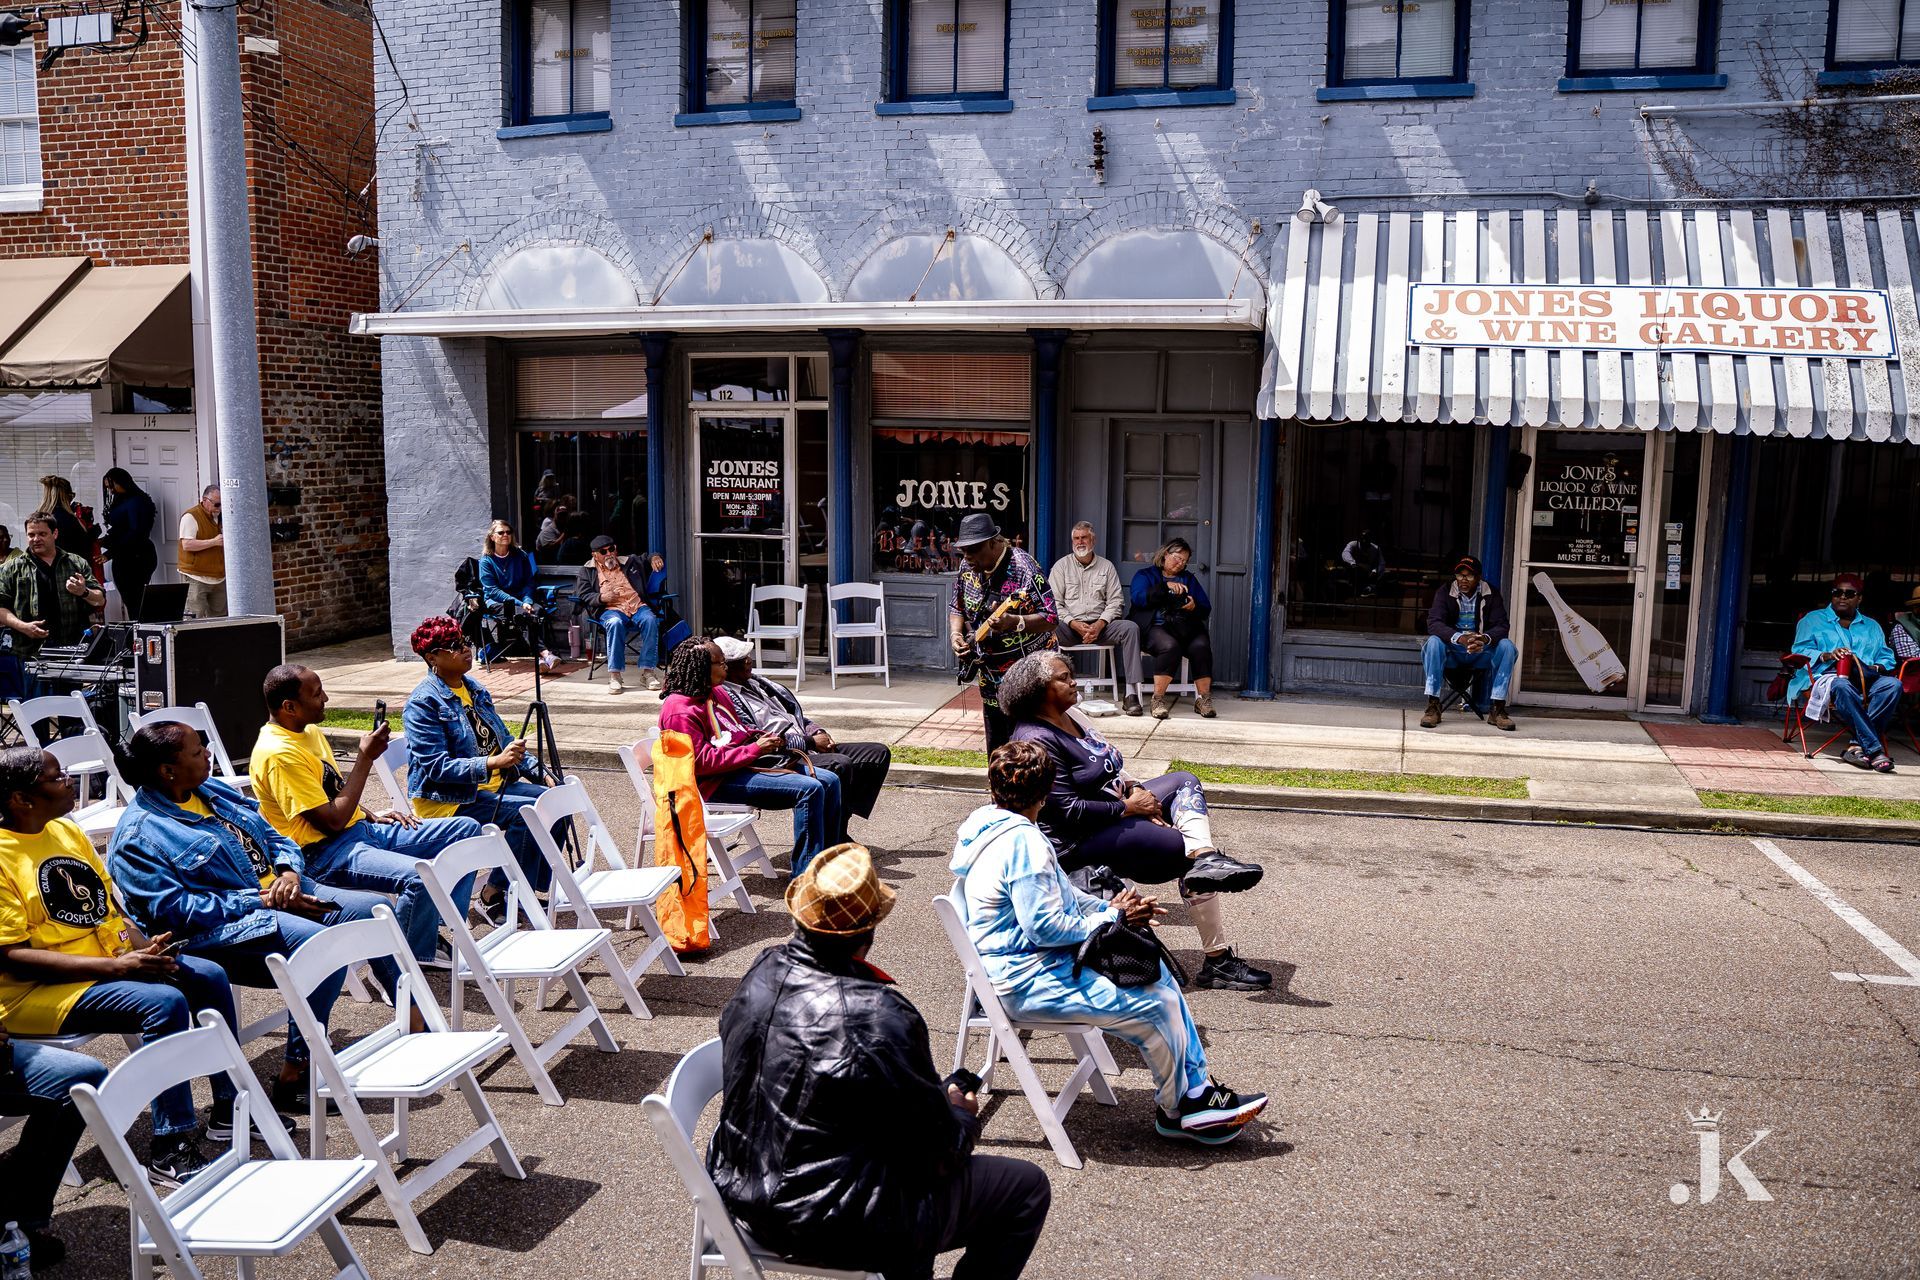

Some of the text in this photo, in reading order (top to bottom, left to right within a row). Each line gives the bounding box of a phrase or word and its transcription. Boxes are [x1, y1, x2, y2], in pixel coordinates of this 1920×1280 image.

[1136, 18, 1197, 28] INSURANCE
[1424, 289, 1876, 323] JONES LIQUOR
[1424, 319, 1878, 351] & WINE GALLERY
[719, 390, 733, 400] 112
[144, 416, 156, 427] 114
[708, 460, 779, 477] JONES
[1561, 465, 1616, 482] JONES
[706, 477, 780, 489] RESTAURANT
[1540, 481, 1637, 495] LIQUOR & WINE
[712, 492, 730, 500] OPEN
[896, 480, 1011, 511] JONES
[1548, 495, 1625, 512] GALLERY
[895, 554, 922, 570] OPEN
[1557, 553, 1582, 562] MUST
[1601, 554, 1610, 563] 21
[49, 859, 89, 871] COMMUNITY
[57, 889, 106, 924] GOSPEL CHOIR
